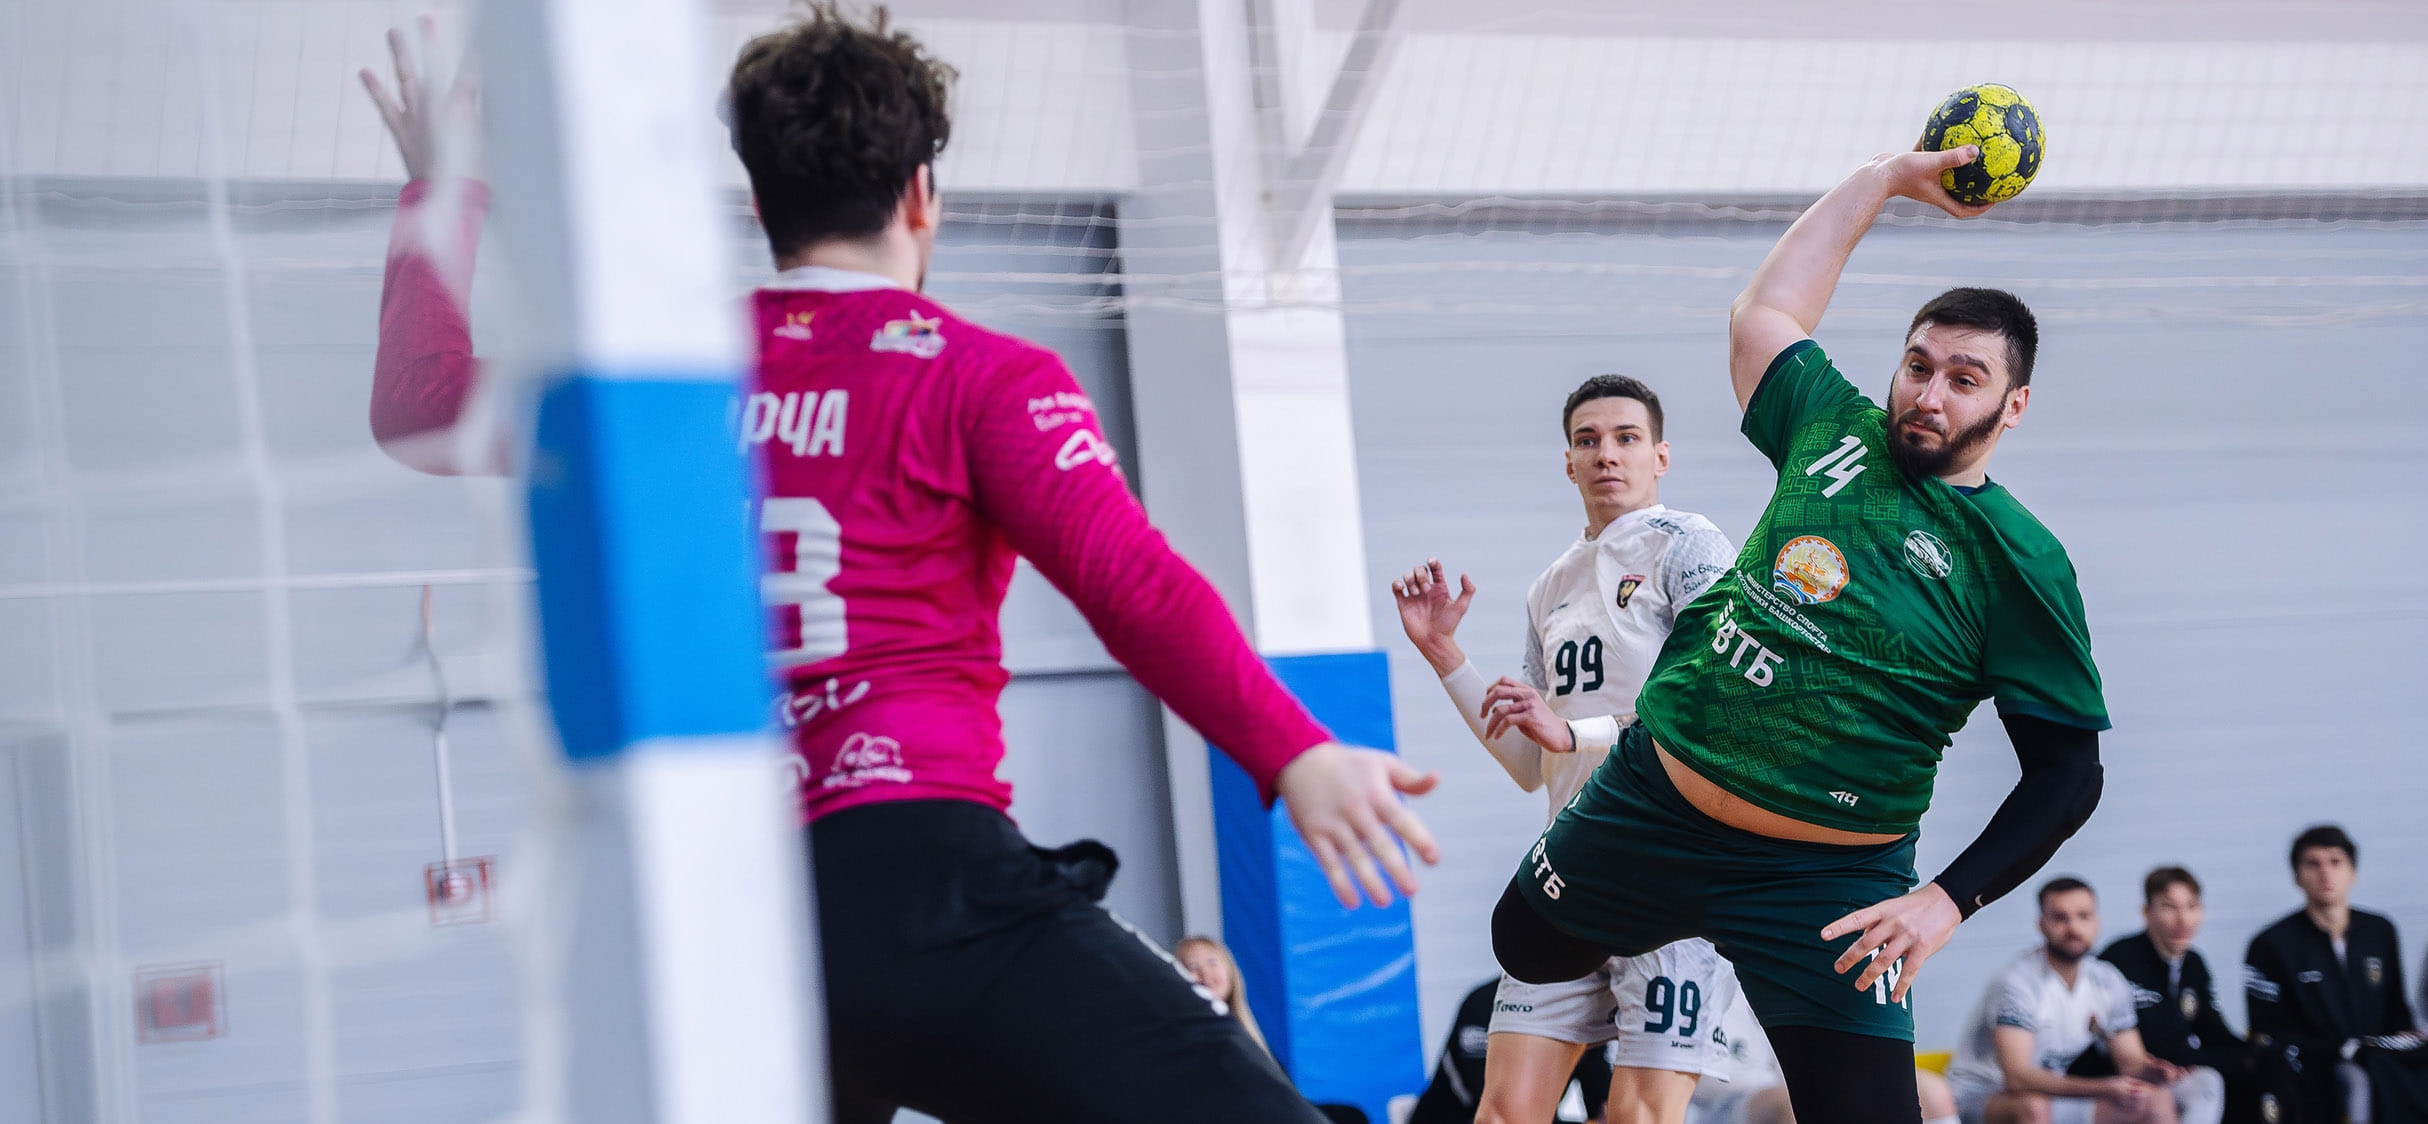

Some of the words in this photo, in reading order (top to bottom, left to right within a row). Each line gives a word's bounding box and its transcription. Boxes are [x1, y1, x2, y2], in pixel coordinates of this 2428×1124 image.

[727, 389, 849, 457] РЧА
[1805, 434, 1869, 499] 14
[1711, 617, 1785, 688] ВТБ
[1796, 613, 1829, 643] СПОРТА
[1555, 635, 1604, 697] 99
[1531, 836, 1567, 900] ВТБ
[1643, 975, 1702, 1037] 99
